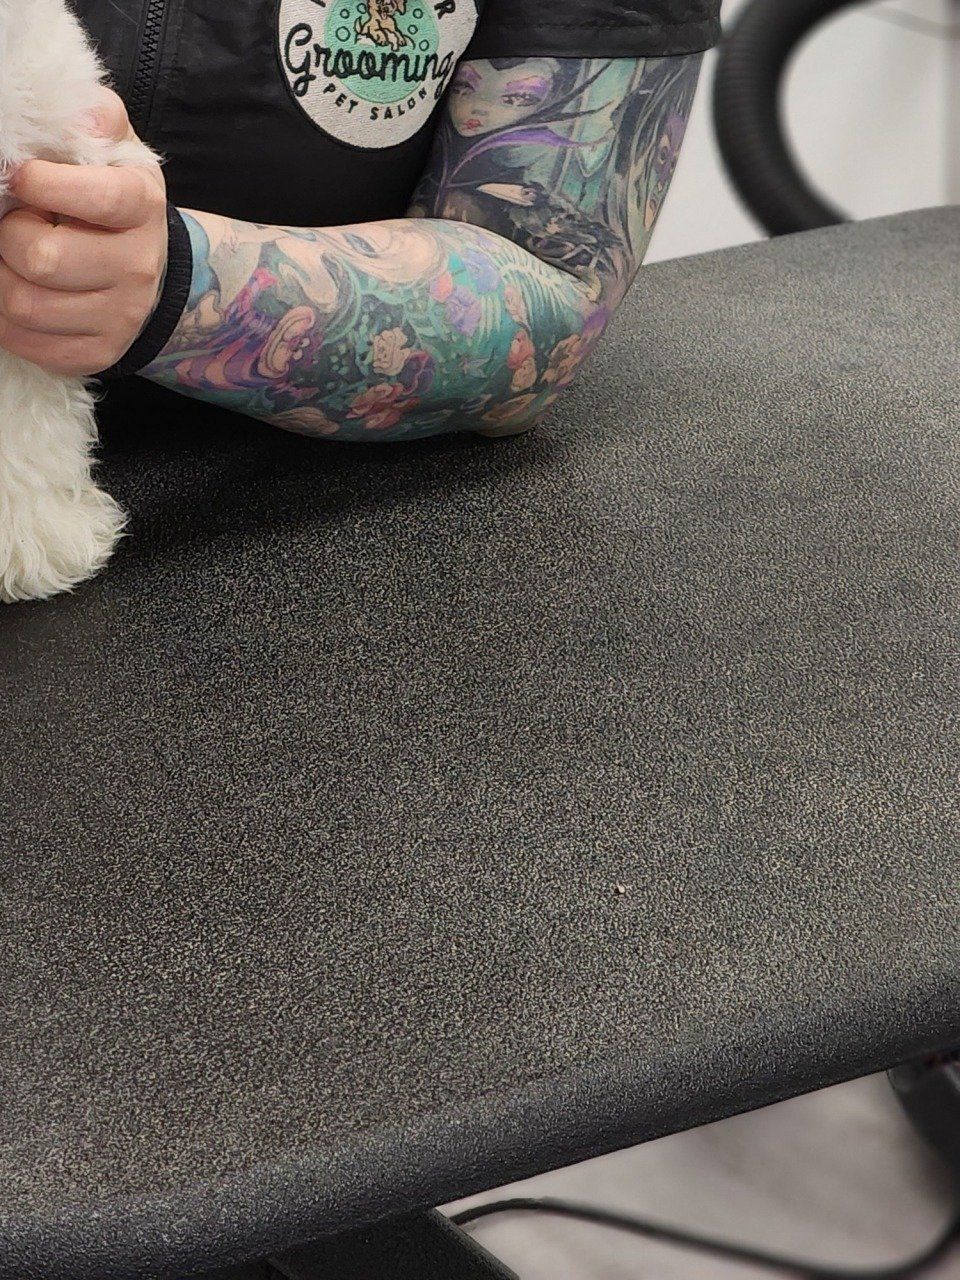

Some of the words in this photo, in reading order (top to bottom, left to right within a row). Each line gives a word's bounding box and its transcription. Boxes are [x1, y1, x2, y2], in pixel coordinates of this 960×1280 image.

[284, 22, 455, 101] Grooming
[322, 82, 359, 114] PET
[369, 86, 428, 121] SALON
